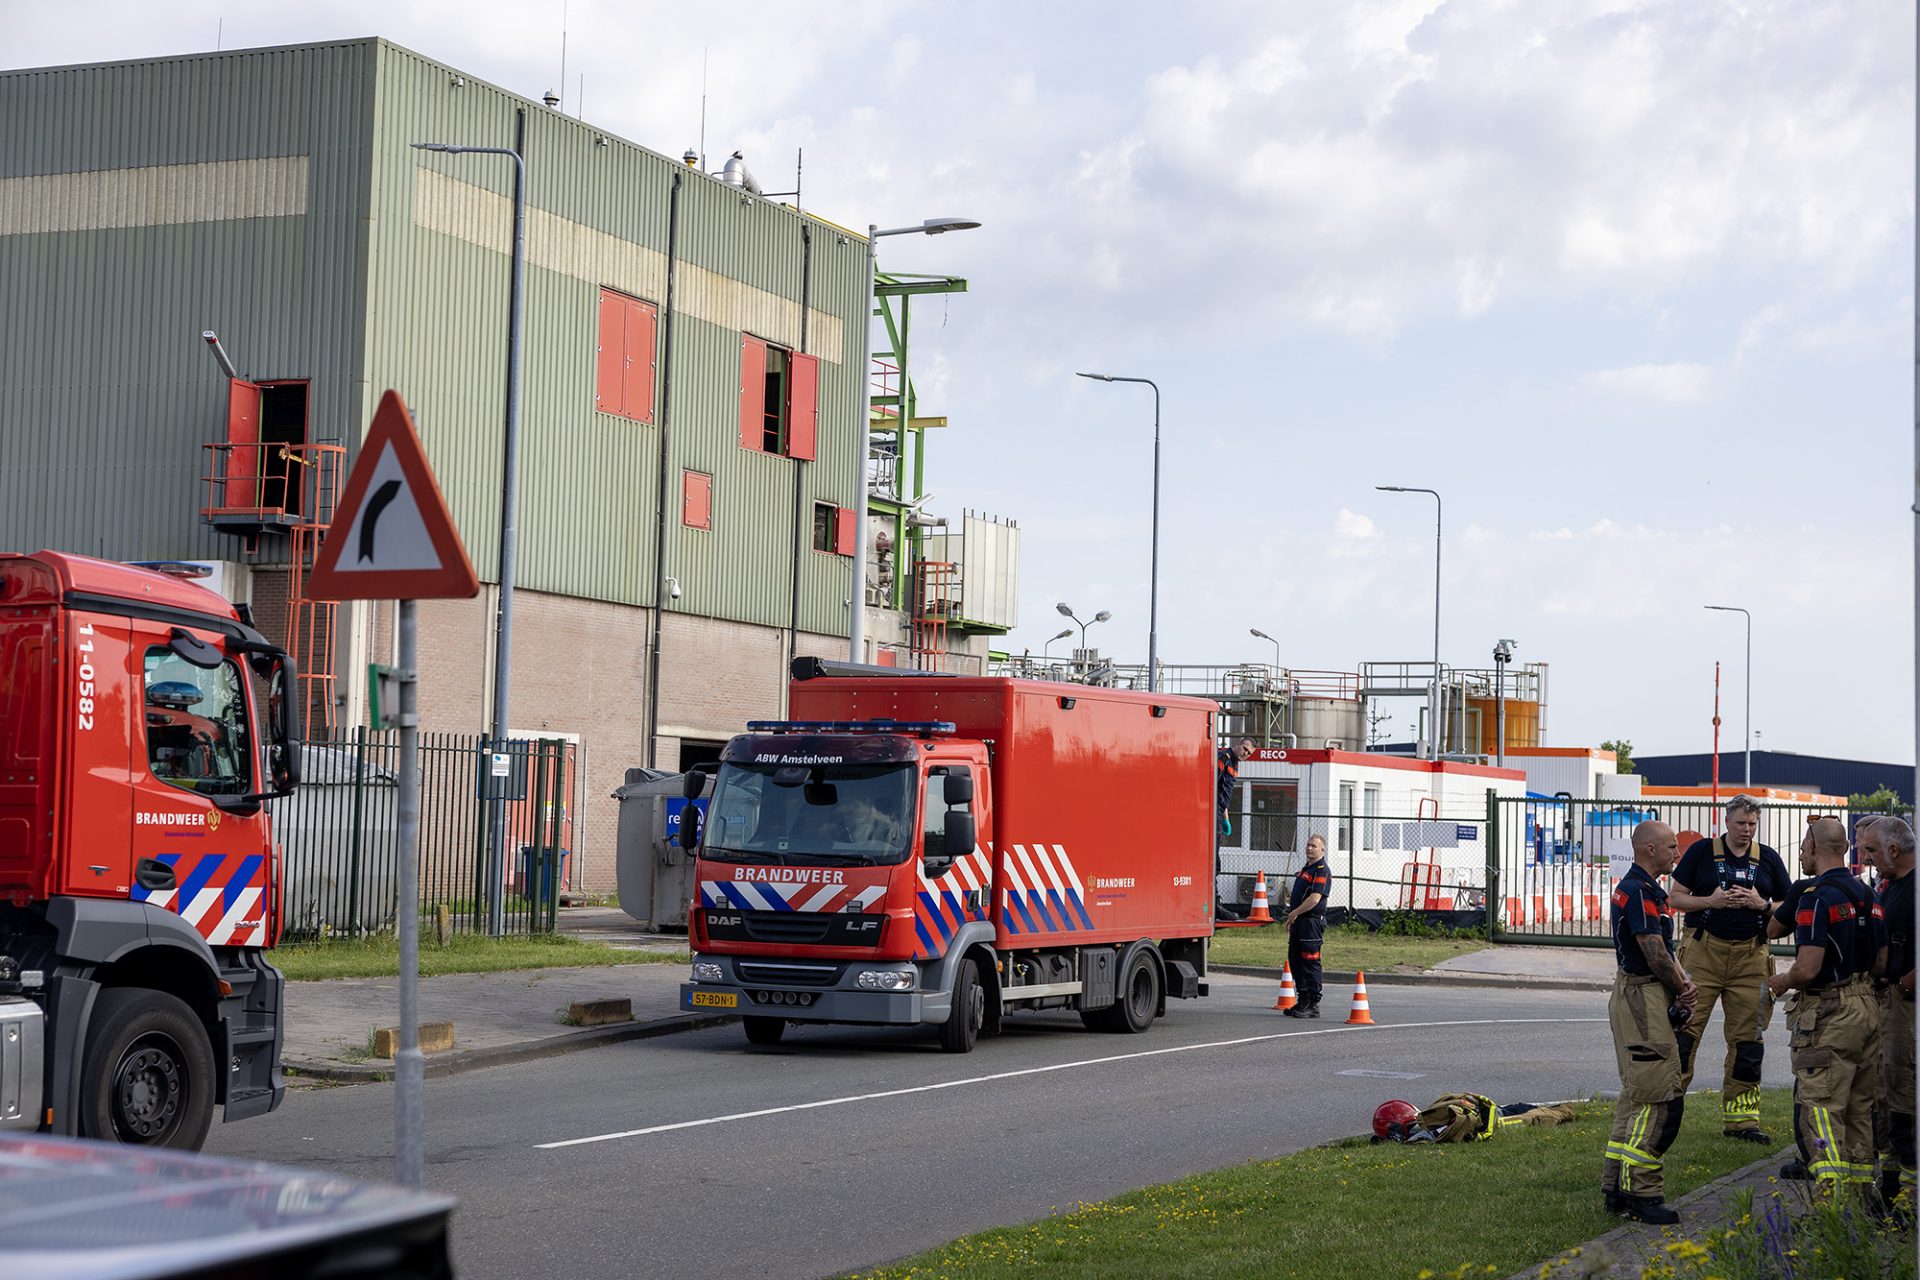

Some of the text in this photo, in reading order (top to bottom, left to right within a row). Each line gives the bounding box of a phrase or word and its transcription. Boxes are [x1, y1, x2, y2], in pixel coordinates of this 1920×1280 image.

[79, 623, 94, 730] 11-0582
[755, 754, 843, 764] ABW Amstelveen
[1260, 750, 1287, 759] RECO
[136, 812, 205, 826] BRANDWEER
[734, 867, 844, 884] BRANDWEER
[1096, 877, 1136, 889] BRANDWEER
[708, 915, 742, 926] DAF
[845, 921, 878, 931] LF
[695, 993, 733, 1006] 57-BDN-1
